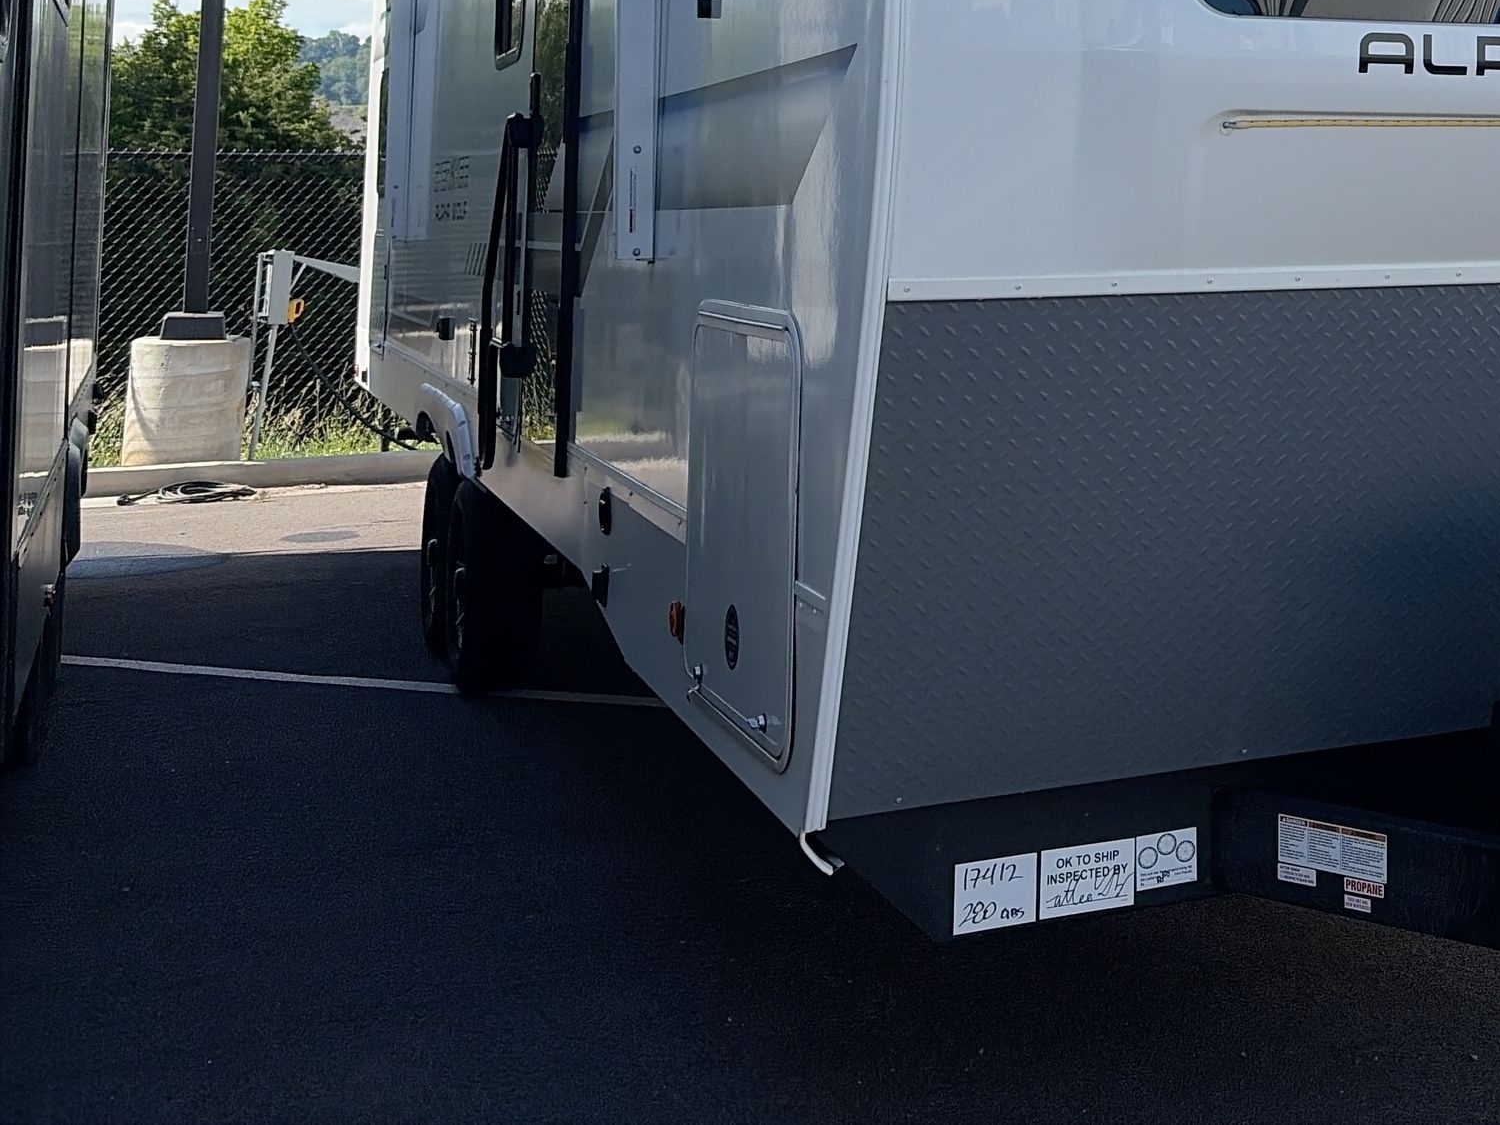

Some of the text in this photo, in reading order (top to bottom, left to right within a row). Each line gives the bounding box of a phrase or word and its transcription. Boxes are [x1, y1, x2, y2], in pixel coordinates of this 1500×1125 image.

[1056, 849, 1120, 869] OK TO SHIP
[1046, 865, 1111, 886] INSPECTED
[1113, 862, 1129, 876] BY
[1345, 878, 1383, 897] PROPANE
[958, 900, 998, 928] 280
